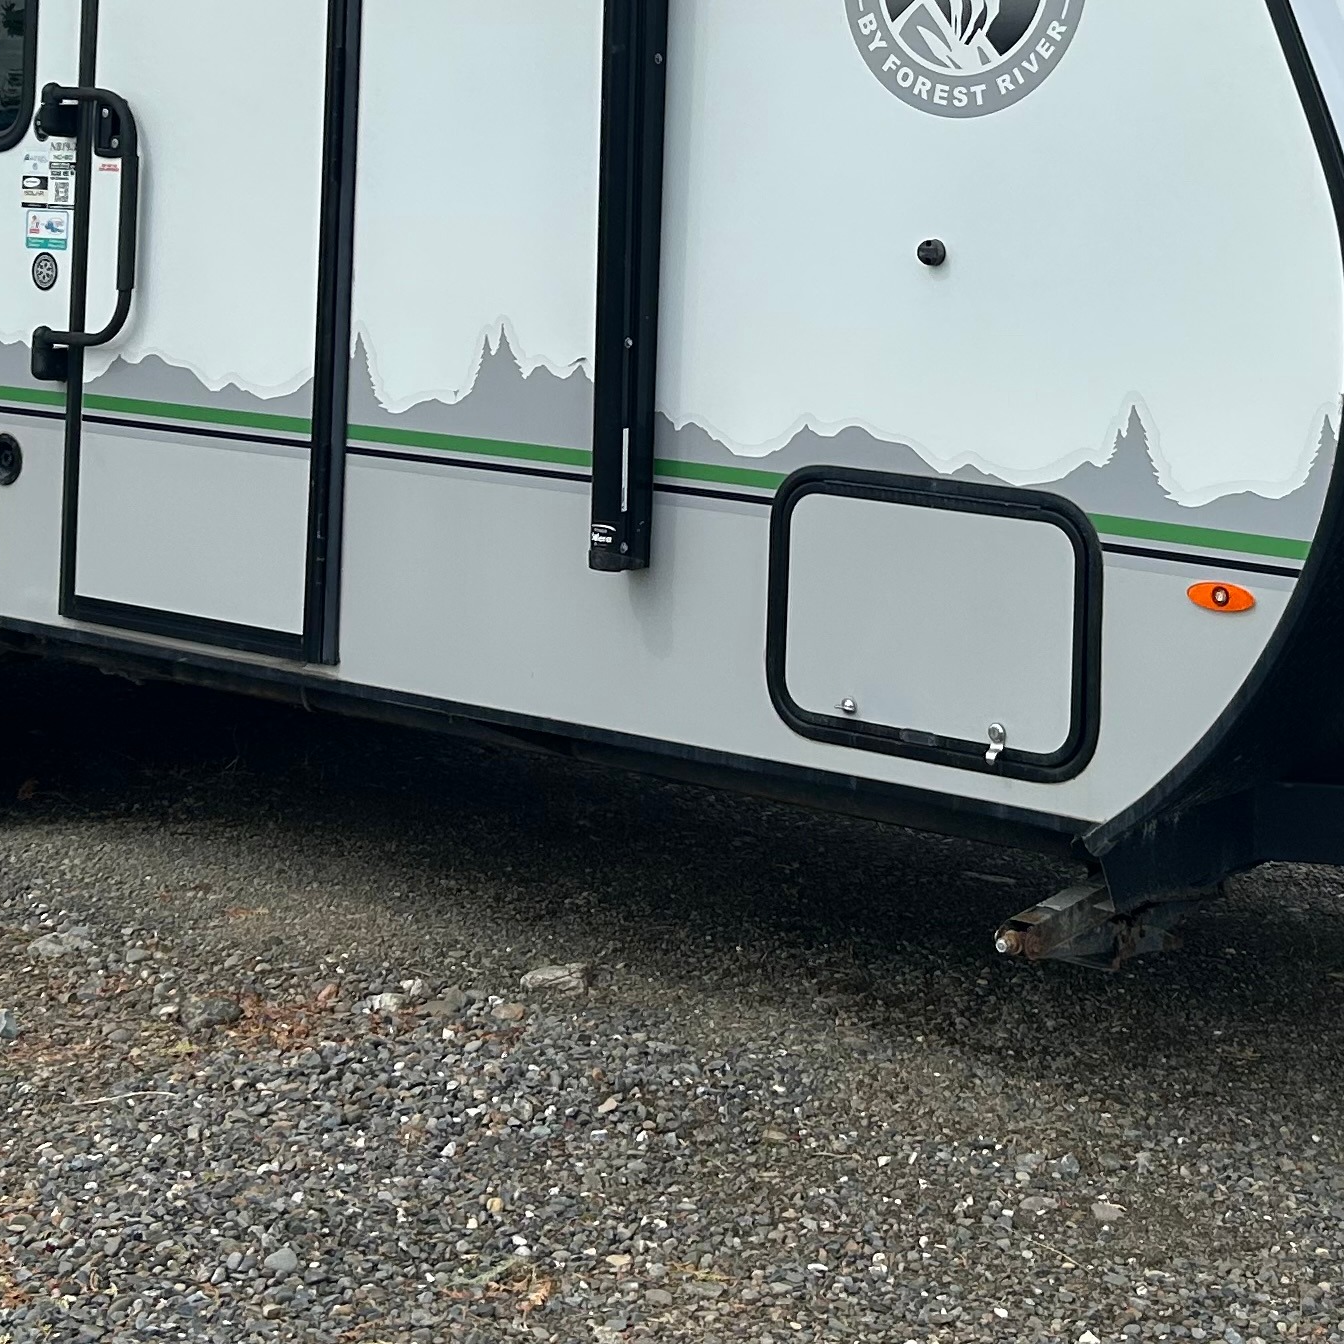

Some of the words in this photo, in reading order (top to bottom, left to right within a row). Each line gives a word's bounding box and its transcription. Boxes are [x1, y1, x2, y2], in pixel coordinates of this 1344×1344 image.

[857, 11, 888, 52] BY
[882, 57, 987, 108] FOREST
[996, 20, 1068, 98] RIVER
